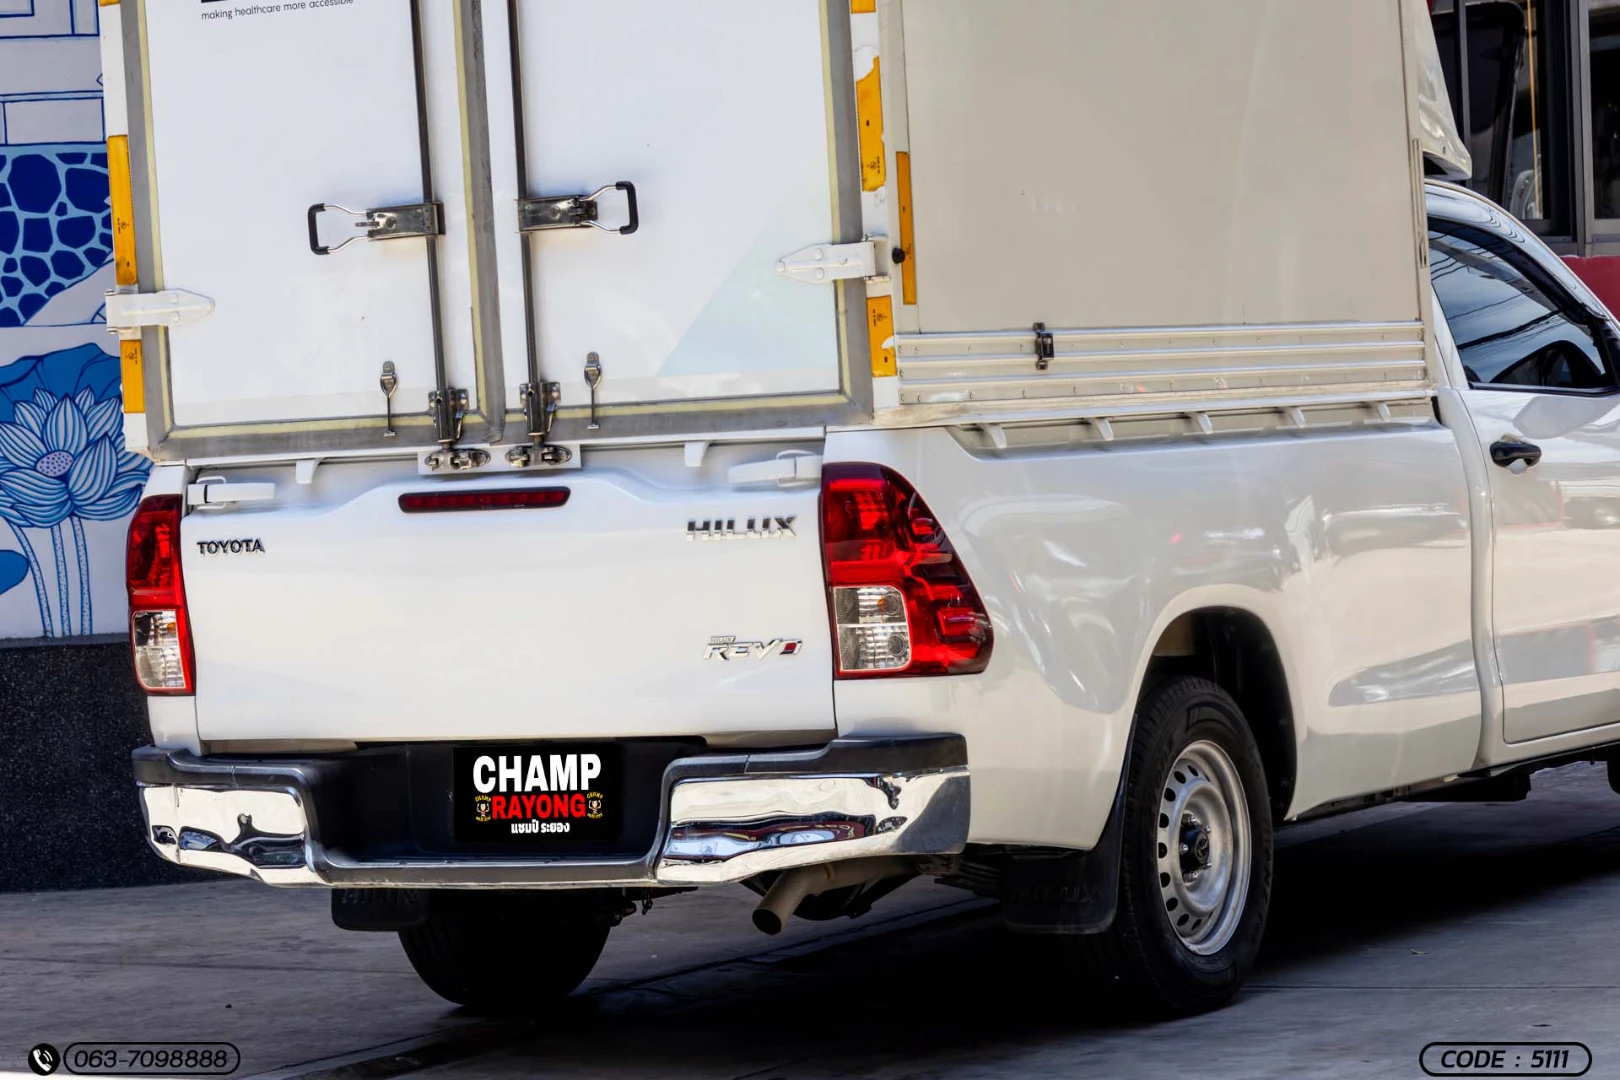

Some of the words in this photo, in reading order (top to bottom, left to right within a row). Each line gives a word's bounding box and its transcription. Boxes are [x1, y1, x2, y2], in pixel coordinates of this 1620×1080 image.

[201, 9, 233, 20] making
[234, 5, 281, 17] healthcare
[283, 2, 306, 11] more
[686, 514, 797, 542] HILUX
[196, 538, 266, 555] TOYOTA
[702, 638, 803, 661] REVO
